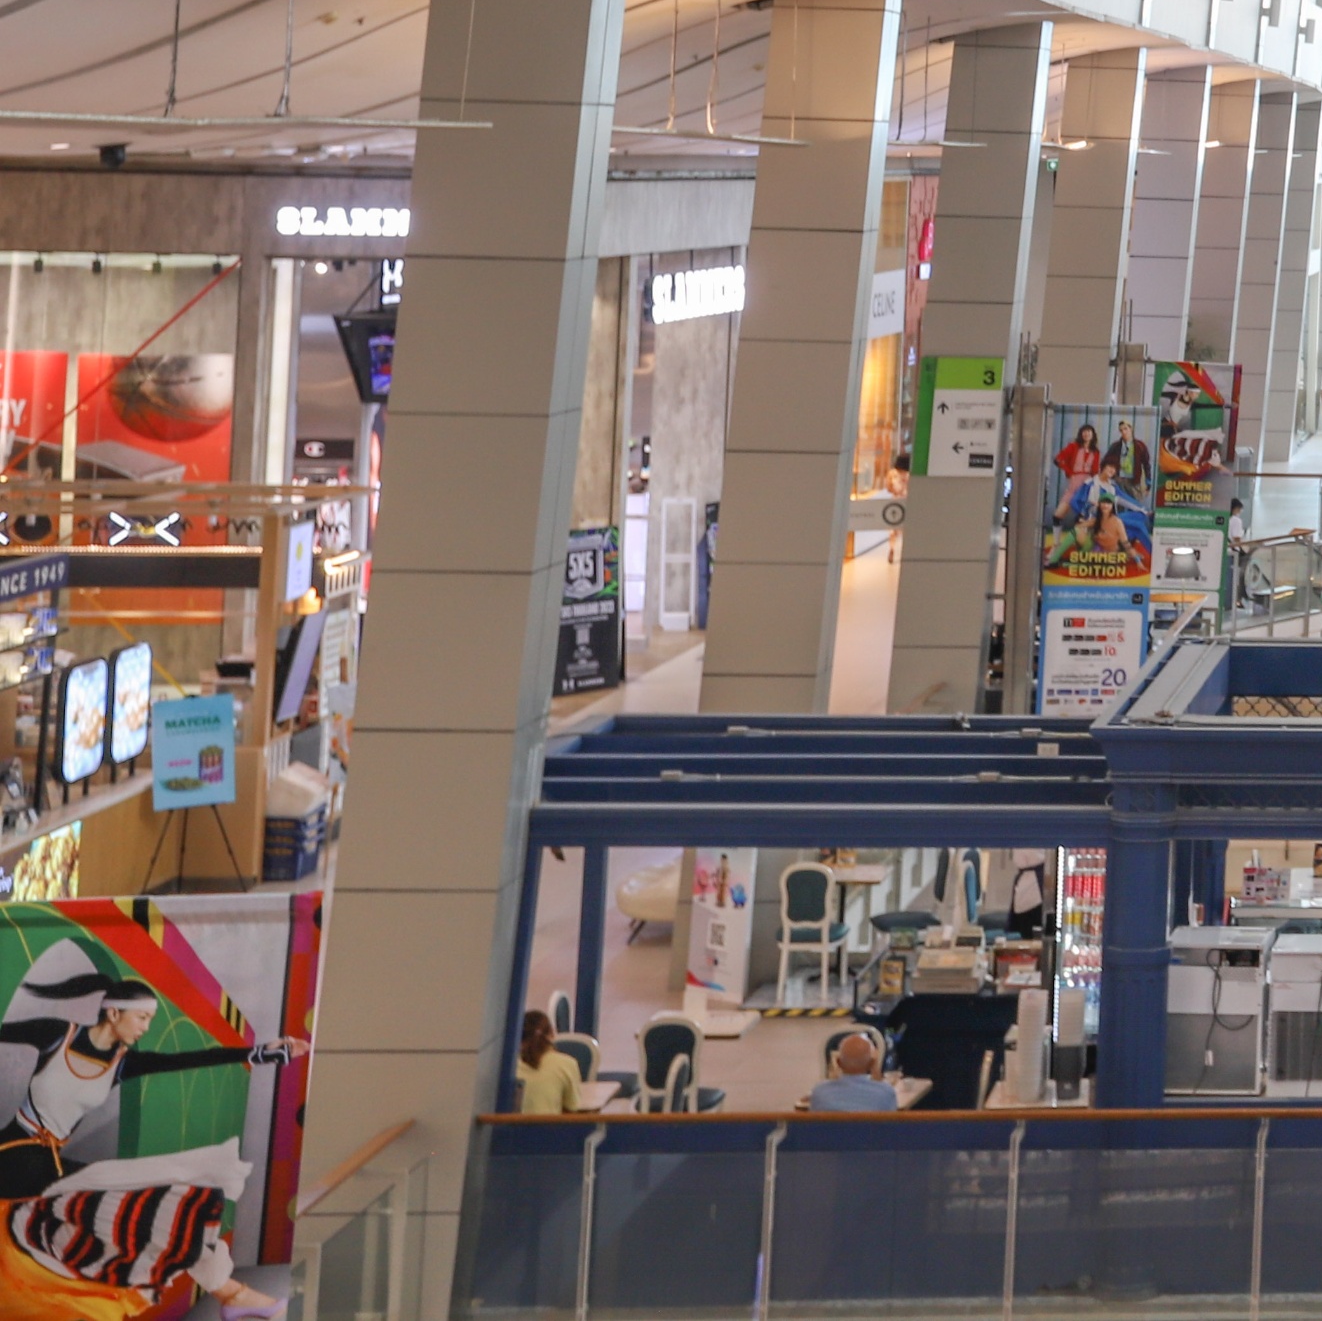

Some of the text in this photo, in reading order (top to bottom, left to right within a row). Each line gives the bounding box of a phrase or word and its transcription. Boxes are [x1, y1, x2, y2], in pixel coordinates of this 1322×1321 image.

[276, 206, 411, 237] SLAMM
[872, 291, 896, 318] CELINE
[983, 370, 995, 386] 3
[1165, 480, 1213, 492] SUMMER
[1164, 491, 1212, 503] EDITION
[1069, 551, 1127, 563] SUMMER
[0, 560, 65, 597] NCE 1949
[1069, 565, 1126, 577] EDITION
[1102, 669, 1127, 686] 20
[165, 716, 221, 730] MATCHA
